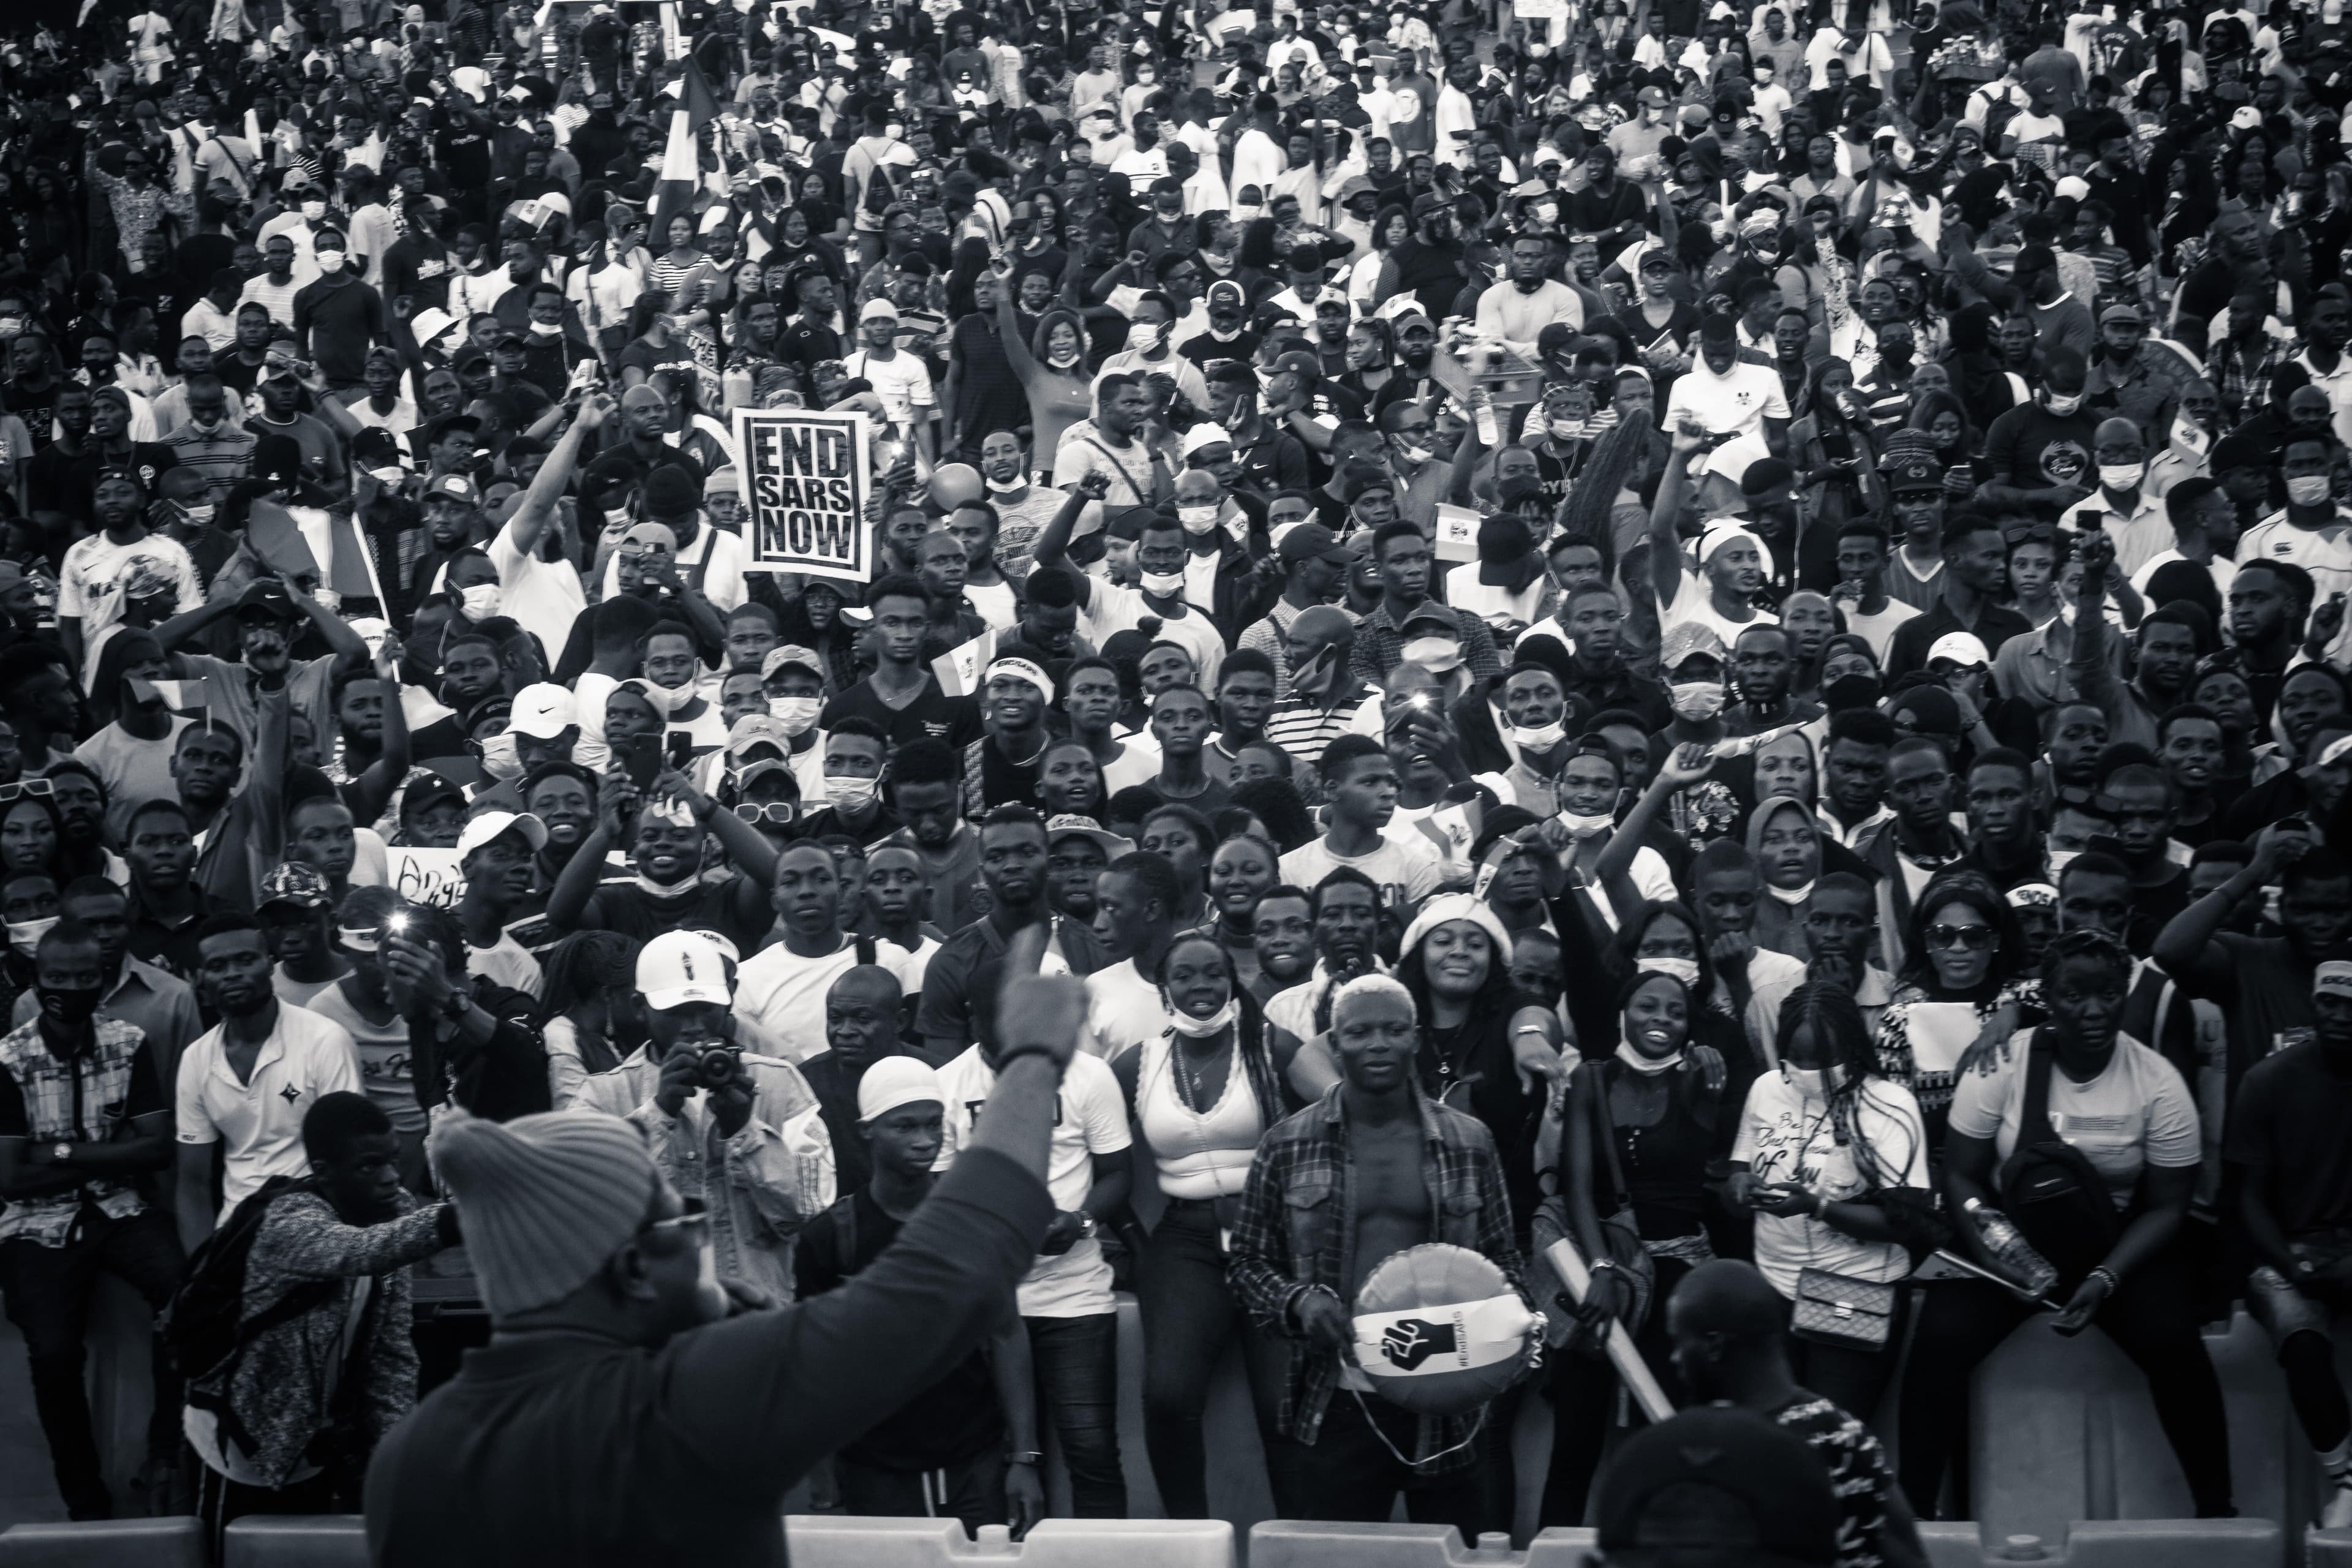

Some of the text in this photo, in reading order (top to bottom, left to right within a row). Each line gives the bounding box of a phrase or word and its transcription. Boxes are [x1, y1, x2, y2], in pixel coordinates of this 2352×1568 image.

[2105, 45, 2125, 67] 17
[753, 427, 848, 478] END
[757, 475, 853, 513] SARS
[760, 508, 852, 559] NOW
